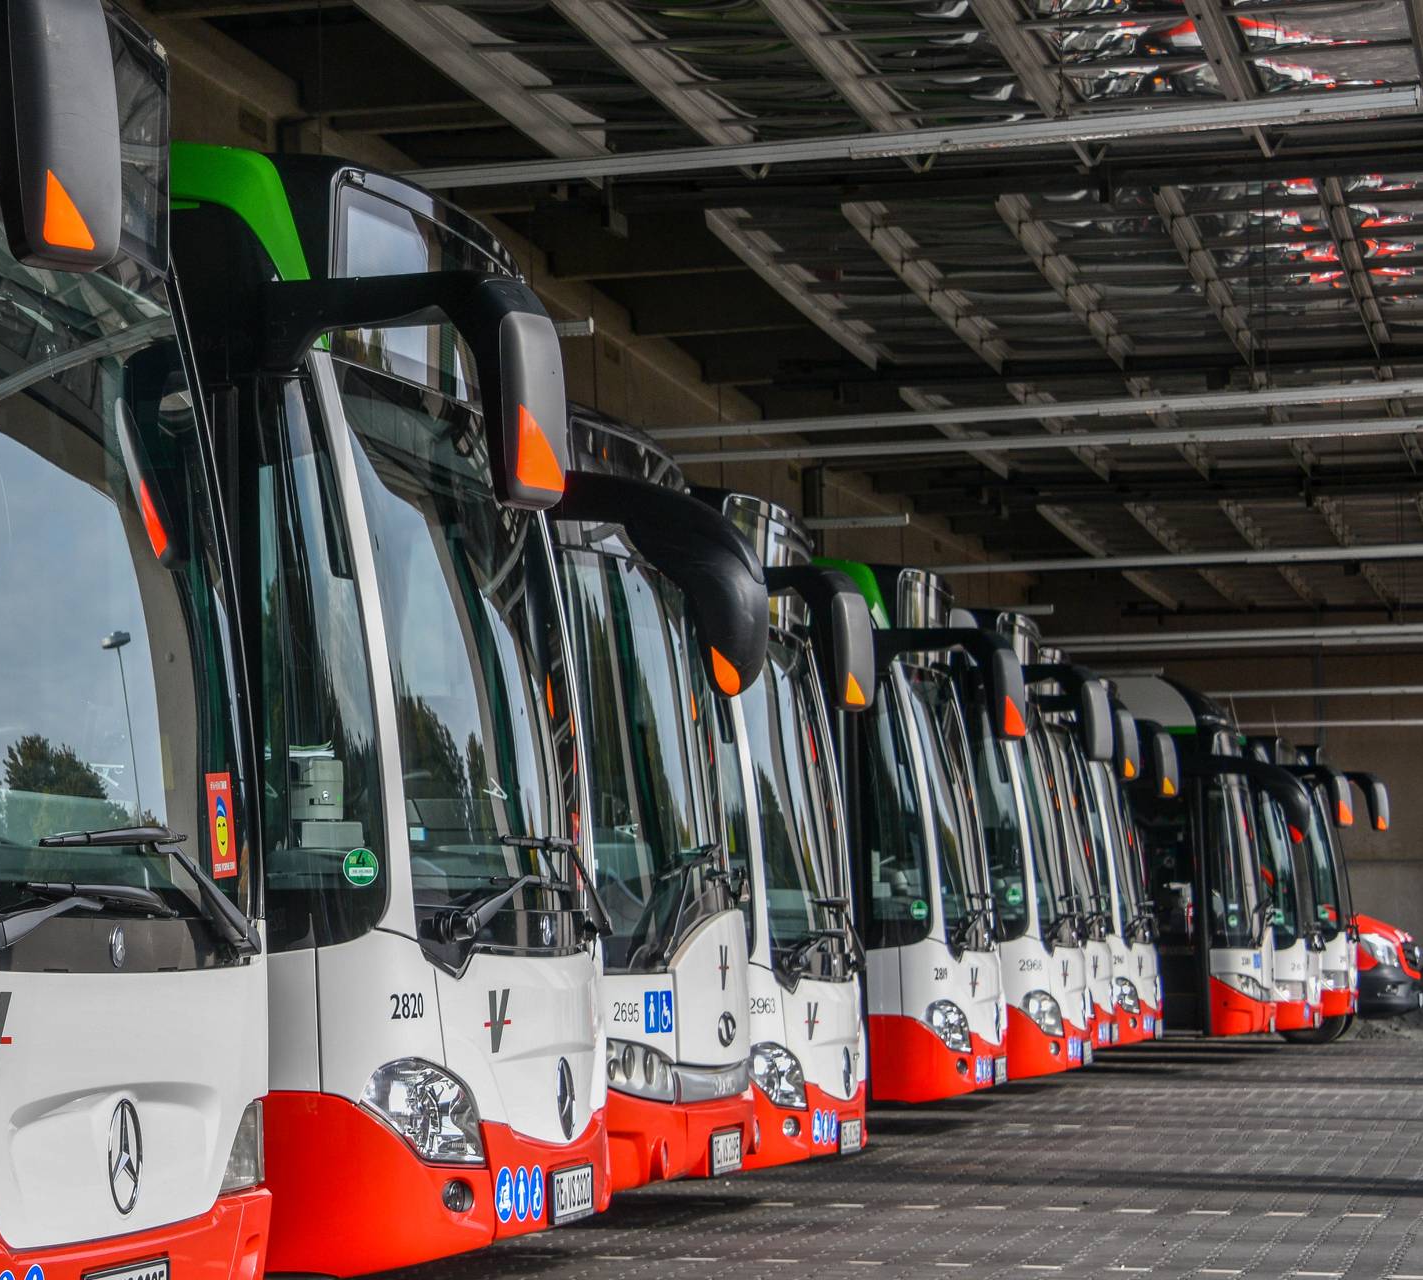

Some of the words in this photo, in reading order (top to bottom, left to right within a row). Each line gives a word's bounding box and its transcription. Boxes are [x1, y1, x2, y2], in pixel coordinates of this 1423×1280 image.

[356, 850, 367, 867] 4
[933, 967, 948, 981] 2819
[390, 992, 424, 1020] 2820
[613, 1001, 640, 1023] 2695
[749, 997, 776, 1015] 2963
